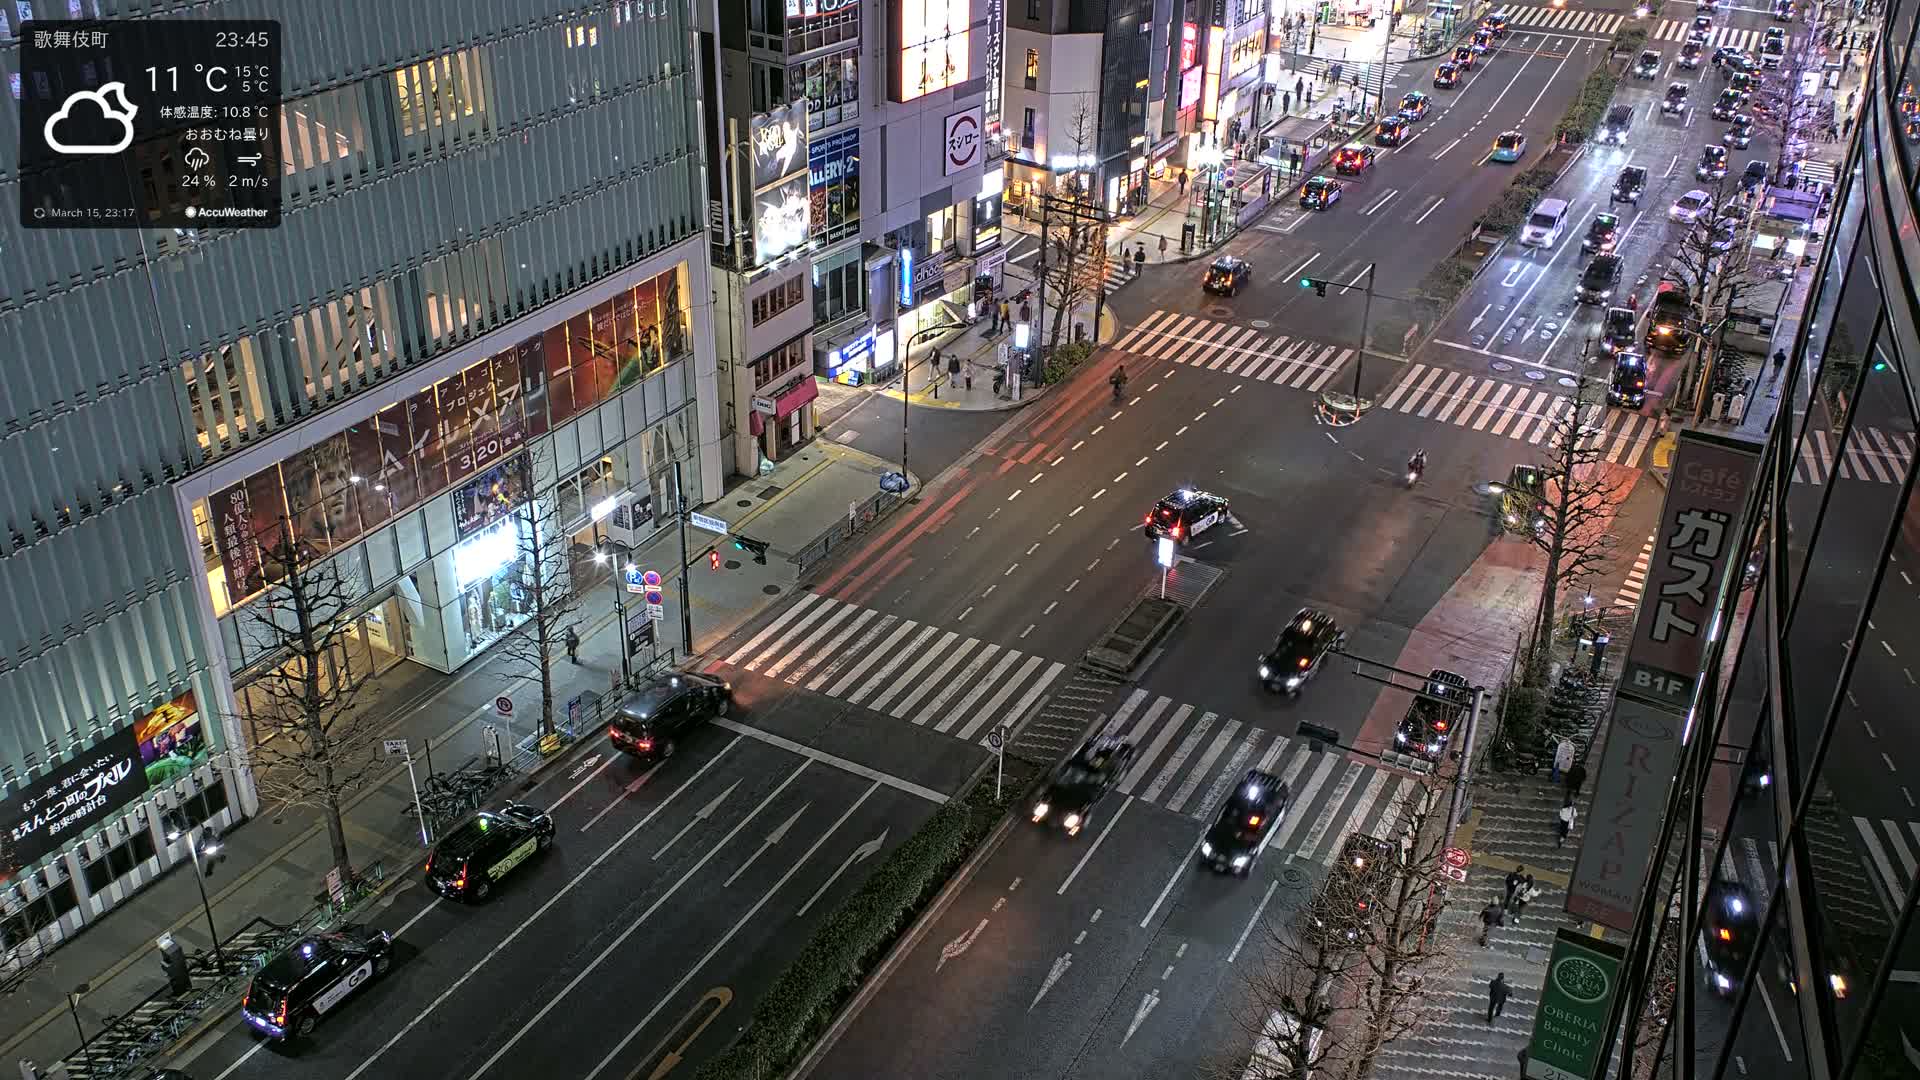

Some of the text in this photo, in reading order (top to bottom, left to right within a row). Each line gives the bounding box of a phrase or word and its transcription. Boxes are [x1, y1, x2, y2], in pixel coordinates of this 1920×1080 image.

[948, 133, 980, 150] スシロー
[710, 200, 723, 233] MUJI
[829, 223, 858, 241] BASKETBALL
[410, 341, 542, 412] ライアン・ゴスリング
[446, 377, 504, 412] プロジェクト
[1651, 510, 1729, 641] ガスト
[1633, 669, 1684, 696] B1F
[23, 753, 114, 812] もう一度、君に会いたい
[48, 794, 107, 836] 約束の時計台
[1601, 744, 1652, 881] RIZAP
[1579, 879, 1632, 904] WOMAN
[1543, 1004, 1598, 1033] OBERIA
[1543, 1020, 1591, 1047] Beauty
[1543, 1039, 1584, 1062] Clinic
